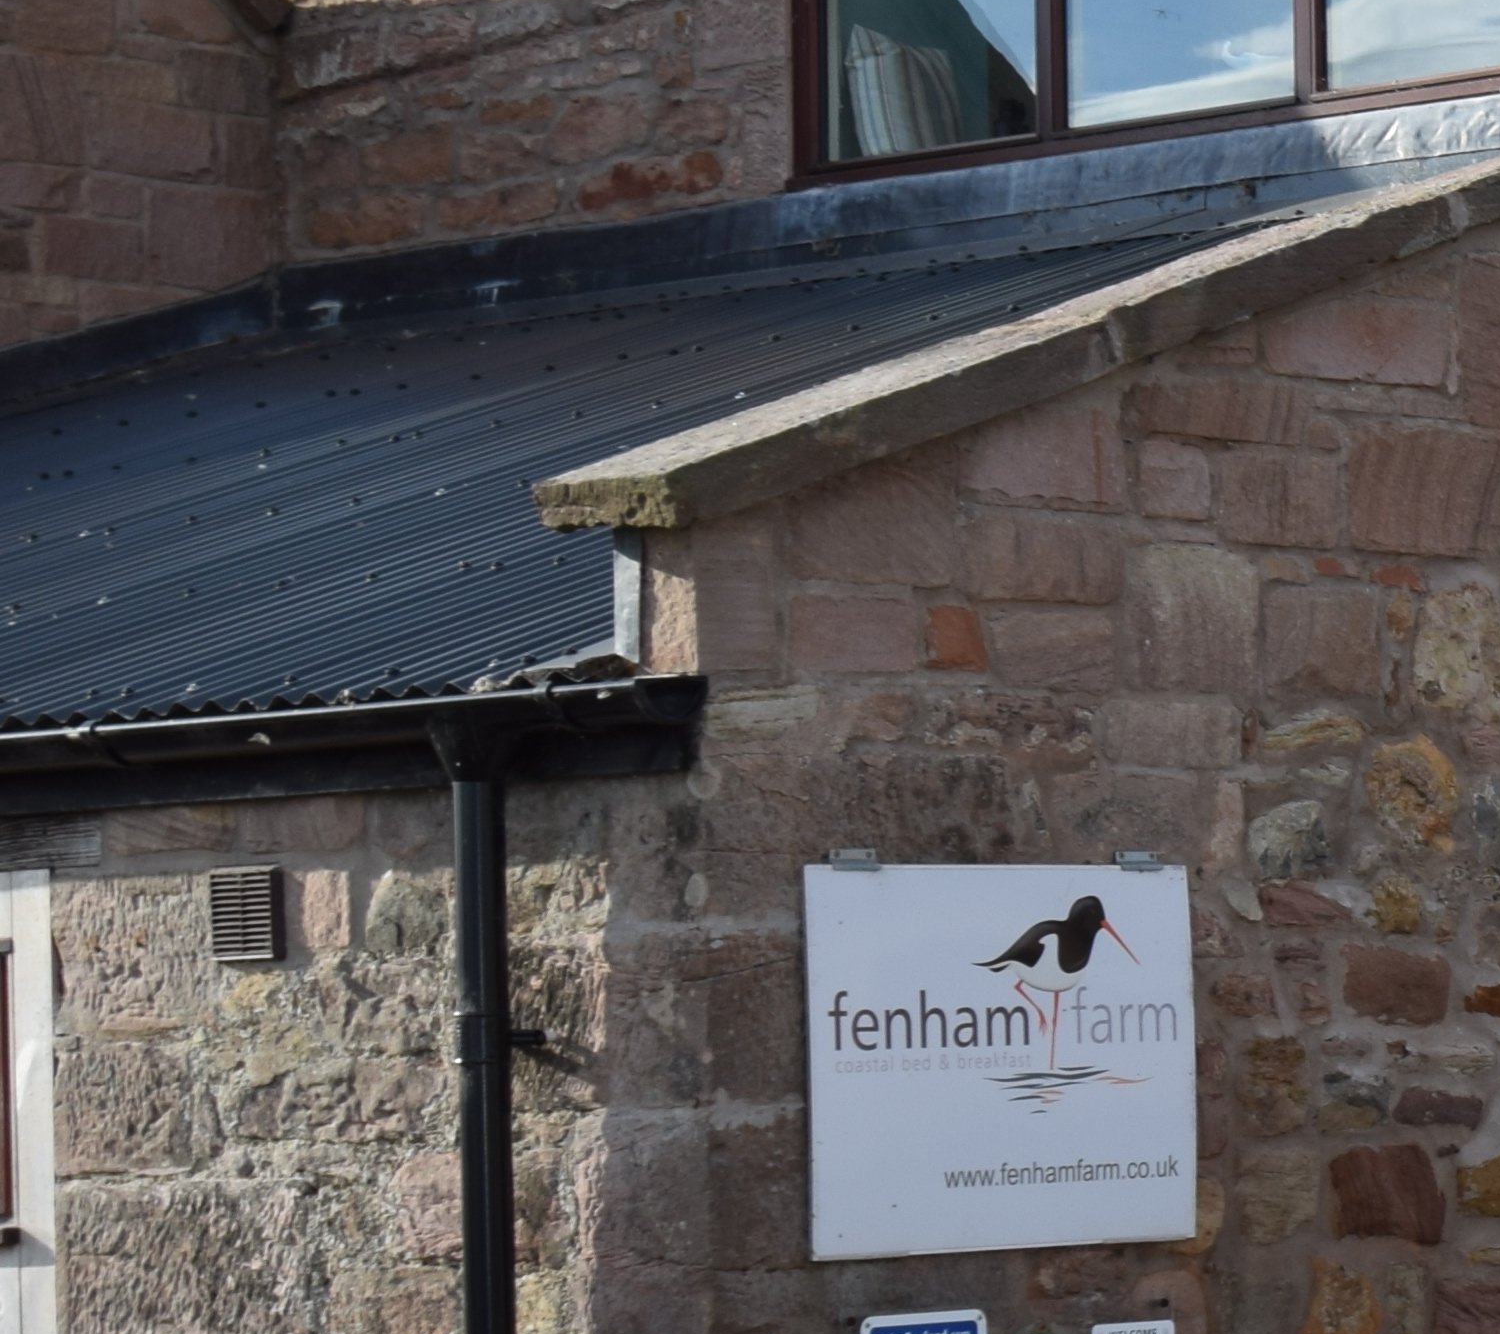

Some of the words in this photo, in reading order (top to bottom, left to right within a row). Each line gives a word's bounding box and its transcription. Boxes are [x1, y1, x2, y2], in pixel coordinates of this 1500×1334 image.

[828, 991, 1031, 1051] fenham
[1070, 986, 1178, 1045] farm
[834, 1056, 895, 1074] coastal
[901, 1056, 932, 1072] bed
[939, 1053, 951, 1071] &
[957, 1051, 1032, 1069] breakfast
[943, 1154, 1180, 1189] www.fenhamfarm.co.uk
